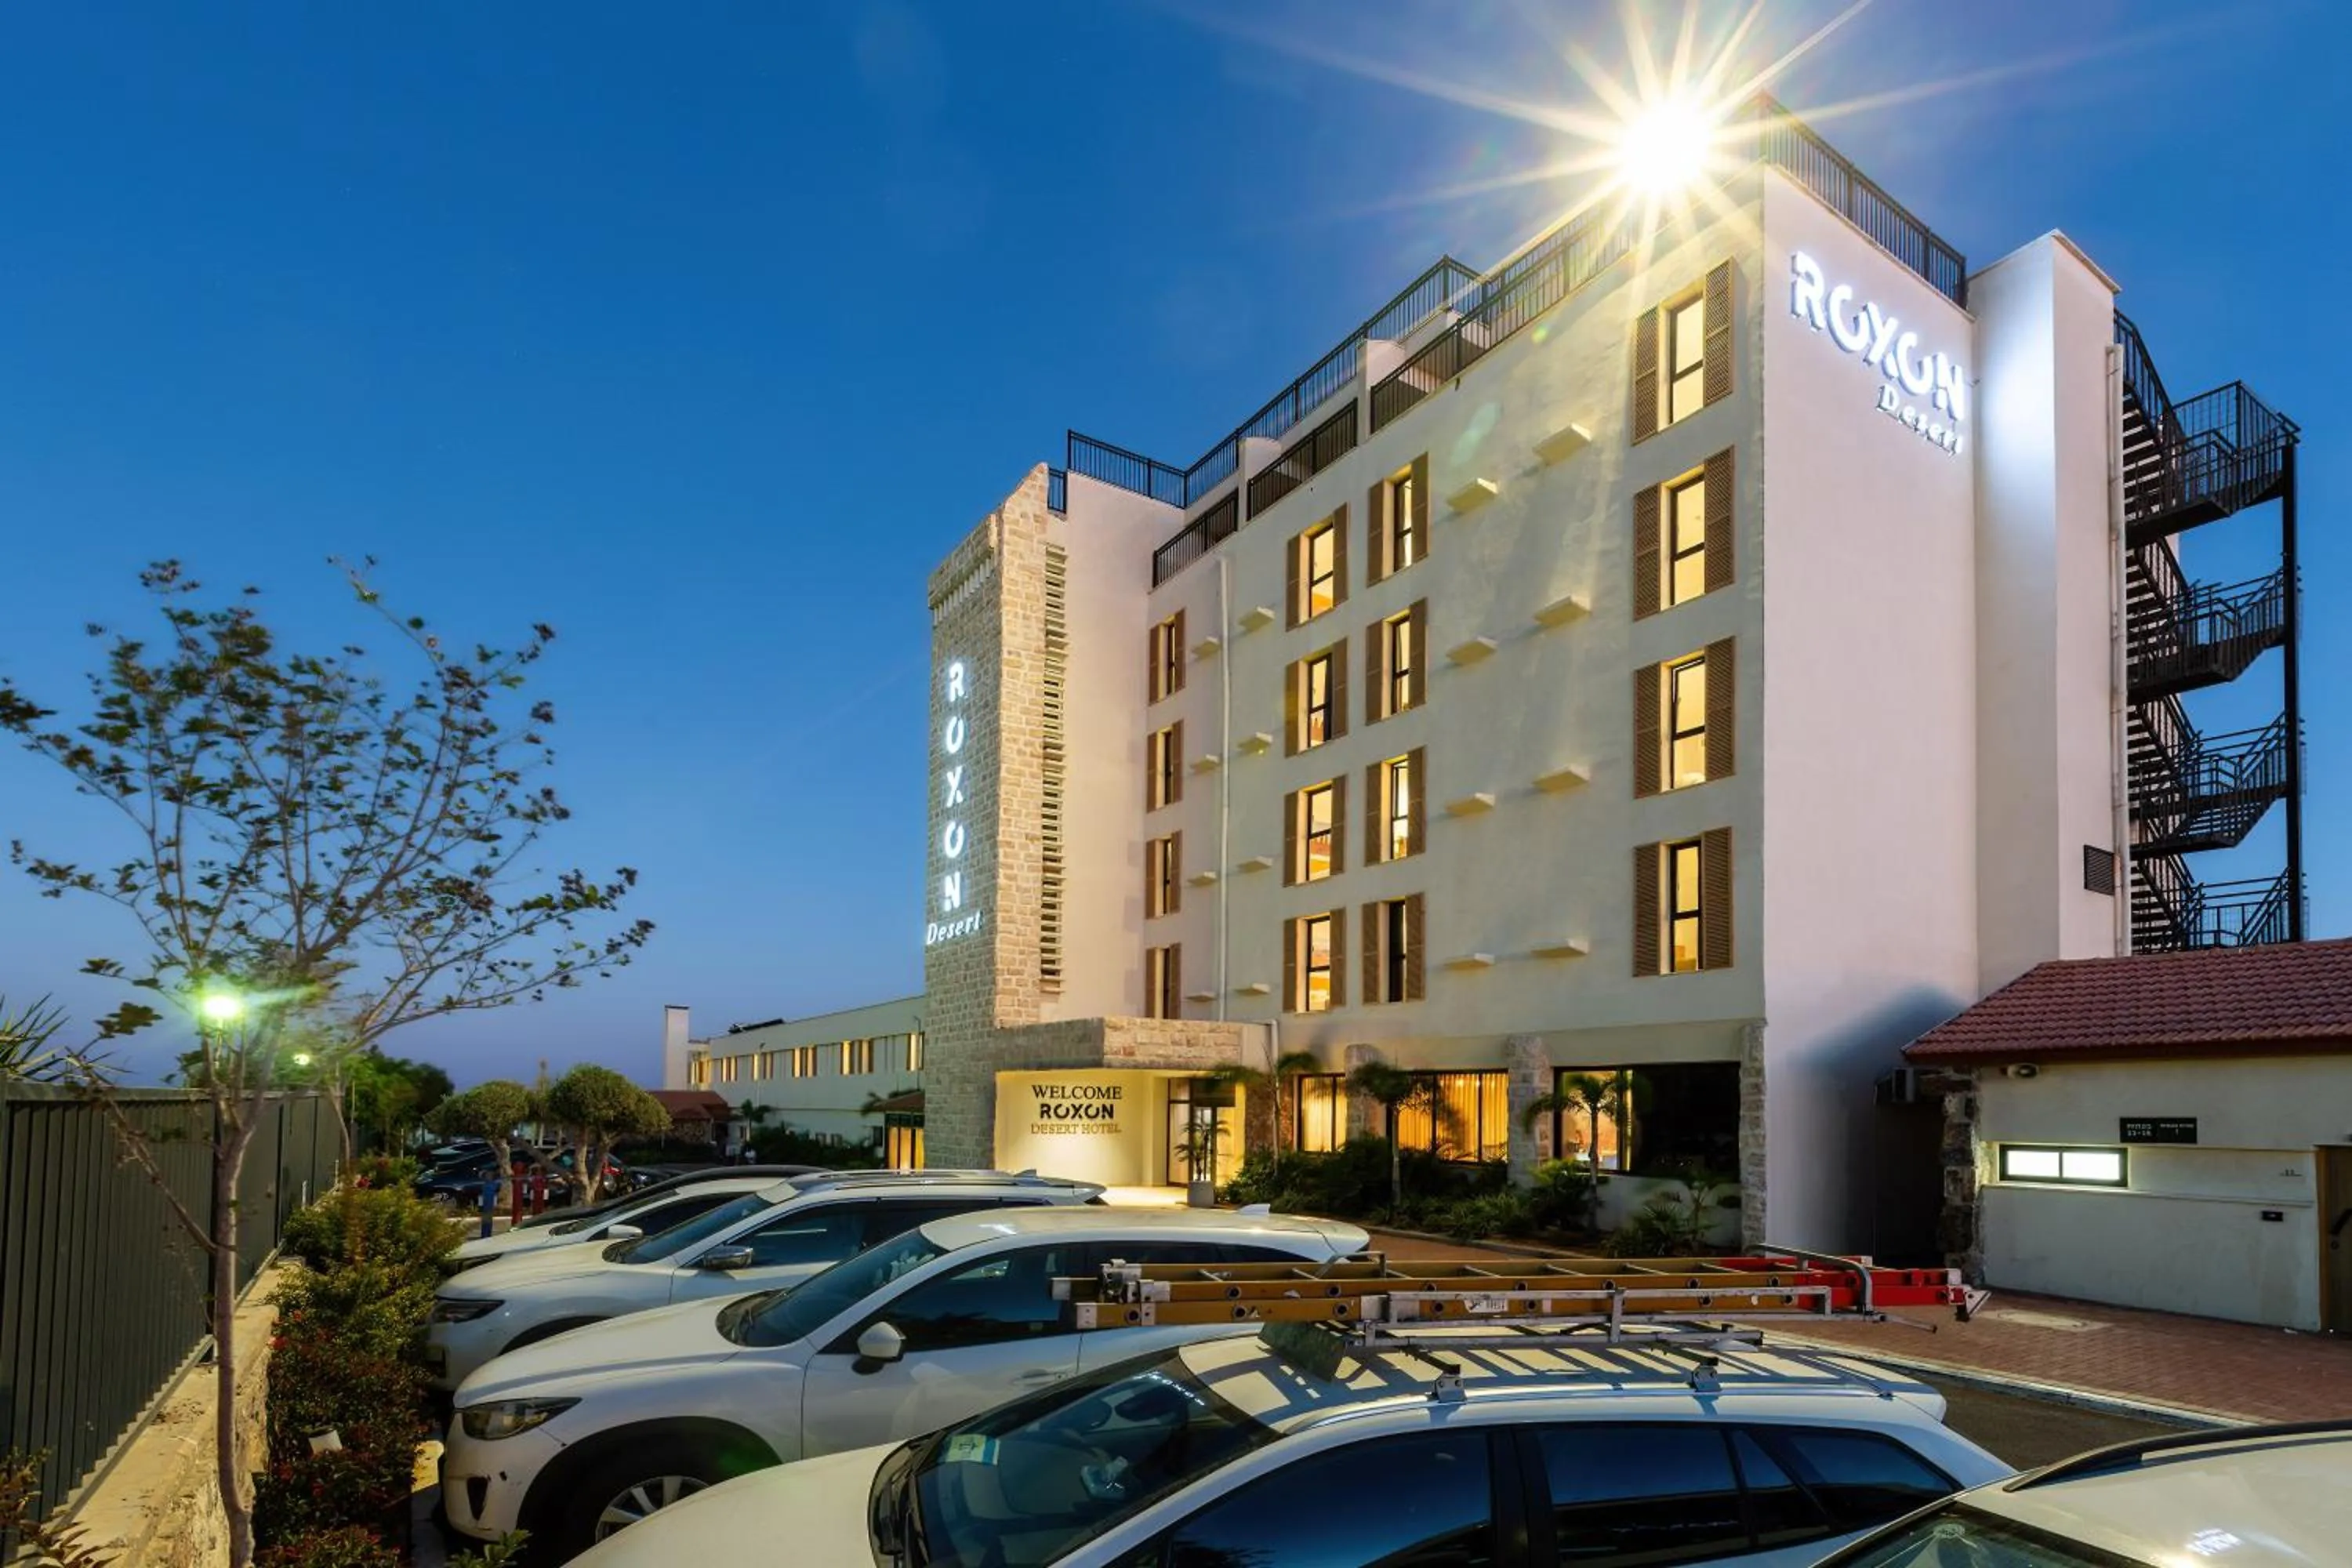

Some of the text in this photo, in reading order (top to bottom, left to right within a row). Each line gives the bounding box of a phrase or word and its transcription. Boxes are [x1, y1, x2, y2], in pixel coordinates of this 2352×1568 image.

[1791, 250, 1965, 421] ROXON
[944, 662, 965, 912] ROXON
[926, 910, 981, 945] Desert
[1032, 1085, 1122, 1100] WELCOME
[1040, 1103, 1114, 1119] ROXON
[1031, 1123, 1122, 1134] DESERT HOTEL
